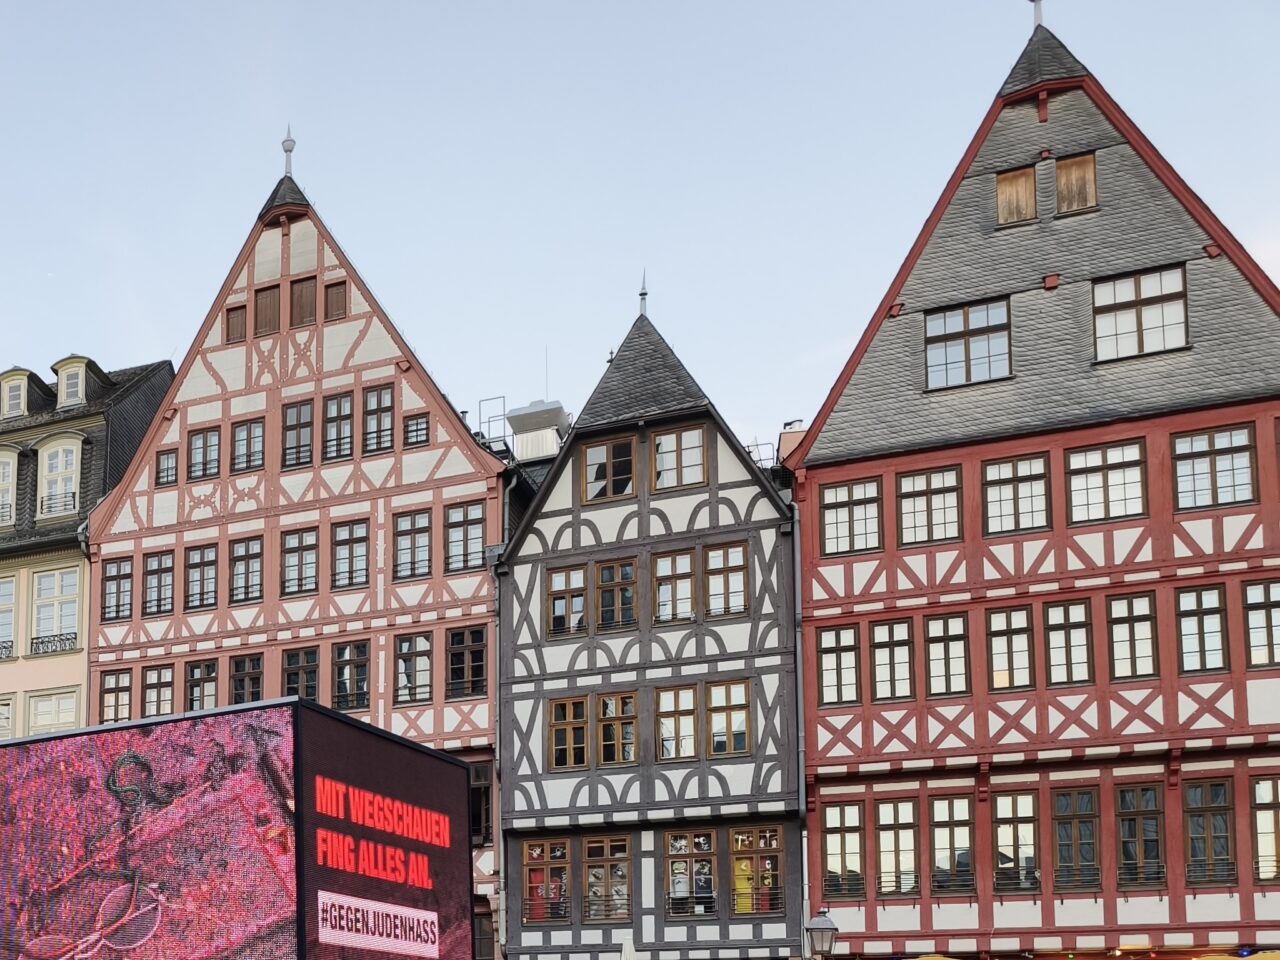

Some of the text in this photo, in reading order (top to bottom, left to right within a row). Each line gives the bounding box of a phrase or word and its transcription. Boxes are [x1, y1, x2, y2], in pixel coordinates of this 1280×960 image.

[315, 774, 451, 848] MIT WEGSCHAUEN
[316, 828, 433, 890] FING ALLES AN.
[320, 901, 437, 945] #GEGENJUDENHASS
